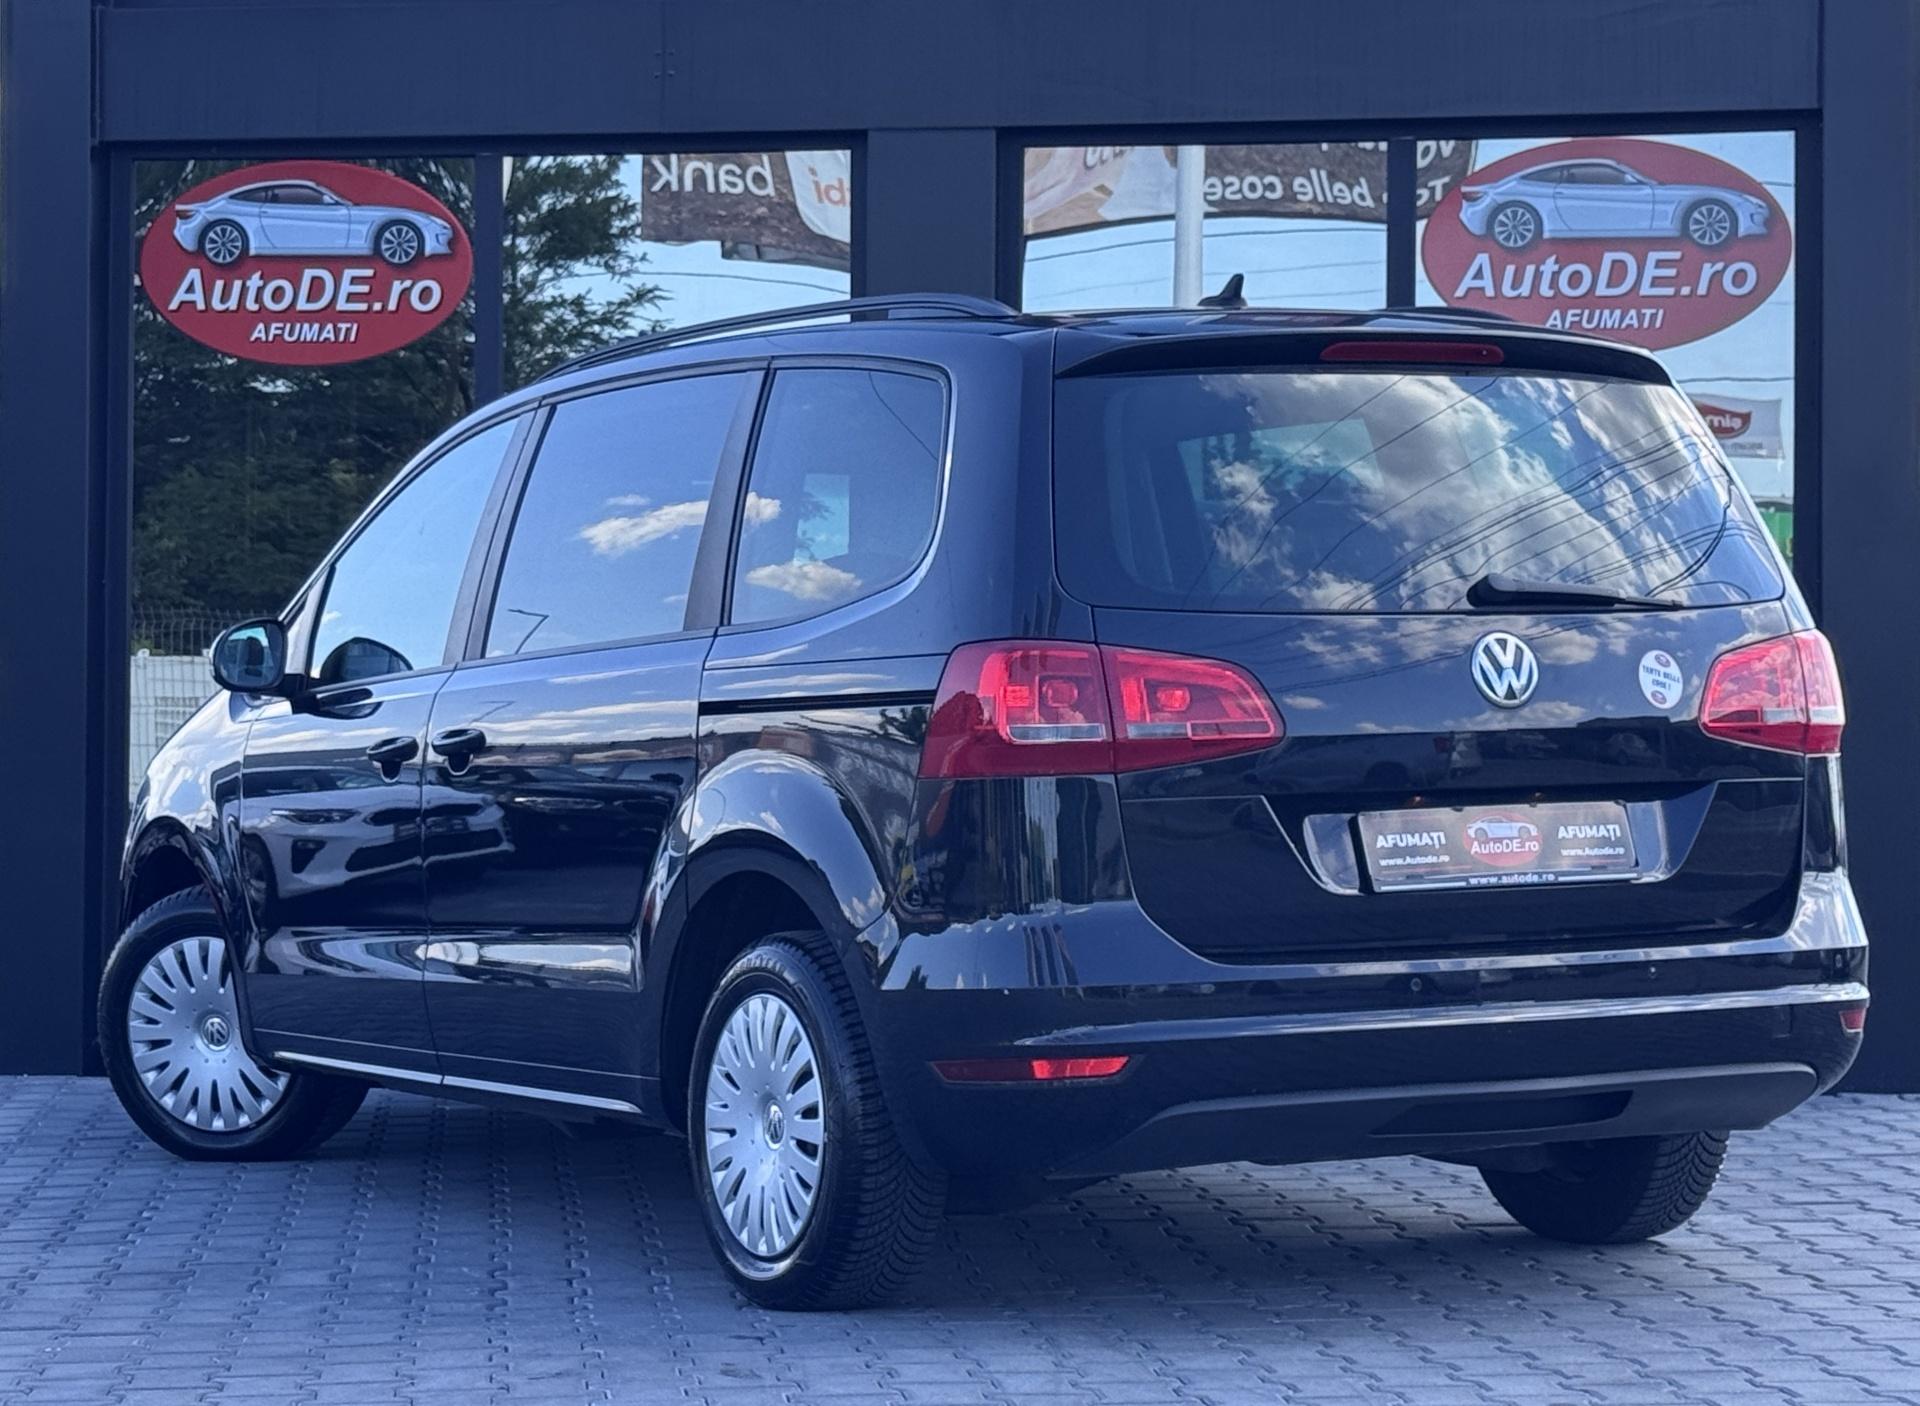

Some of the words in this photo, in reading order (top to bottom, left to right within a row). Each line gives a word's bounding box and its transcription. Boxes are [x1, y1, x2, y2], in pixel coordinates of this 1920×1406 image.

[1453, 250, 1758, 299] AutoDE.ro
[168, 268, 443, 313] AutoDE.ro
[1545, 308, 1664, 331] AFUMATI
[250, 322, 359, 344] AFUMATI
[1470, 838, 1540, 855] AutoDE.ro
[1468, 872, 1556, 885] www.autode.ro
